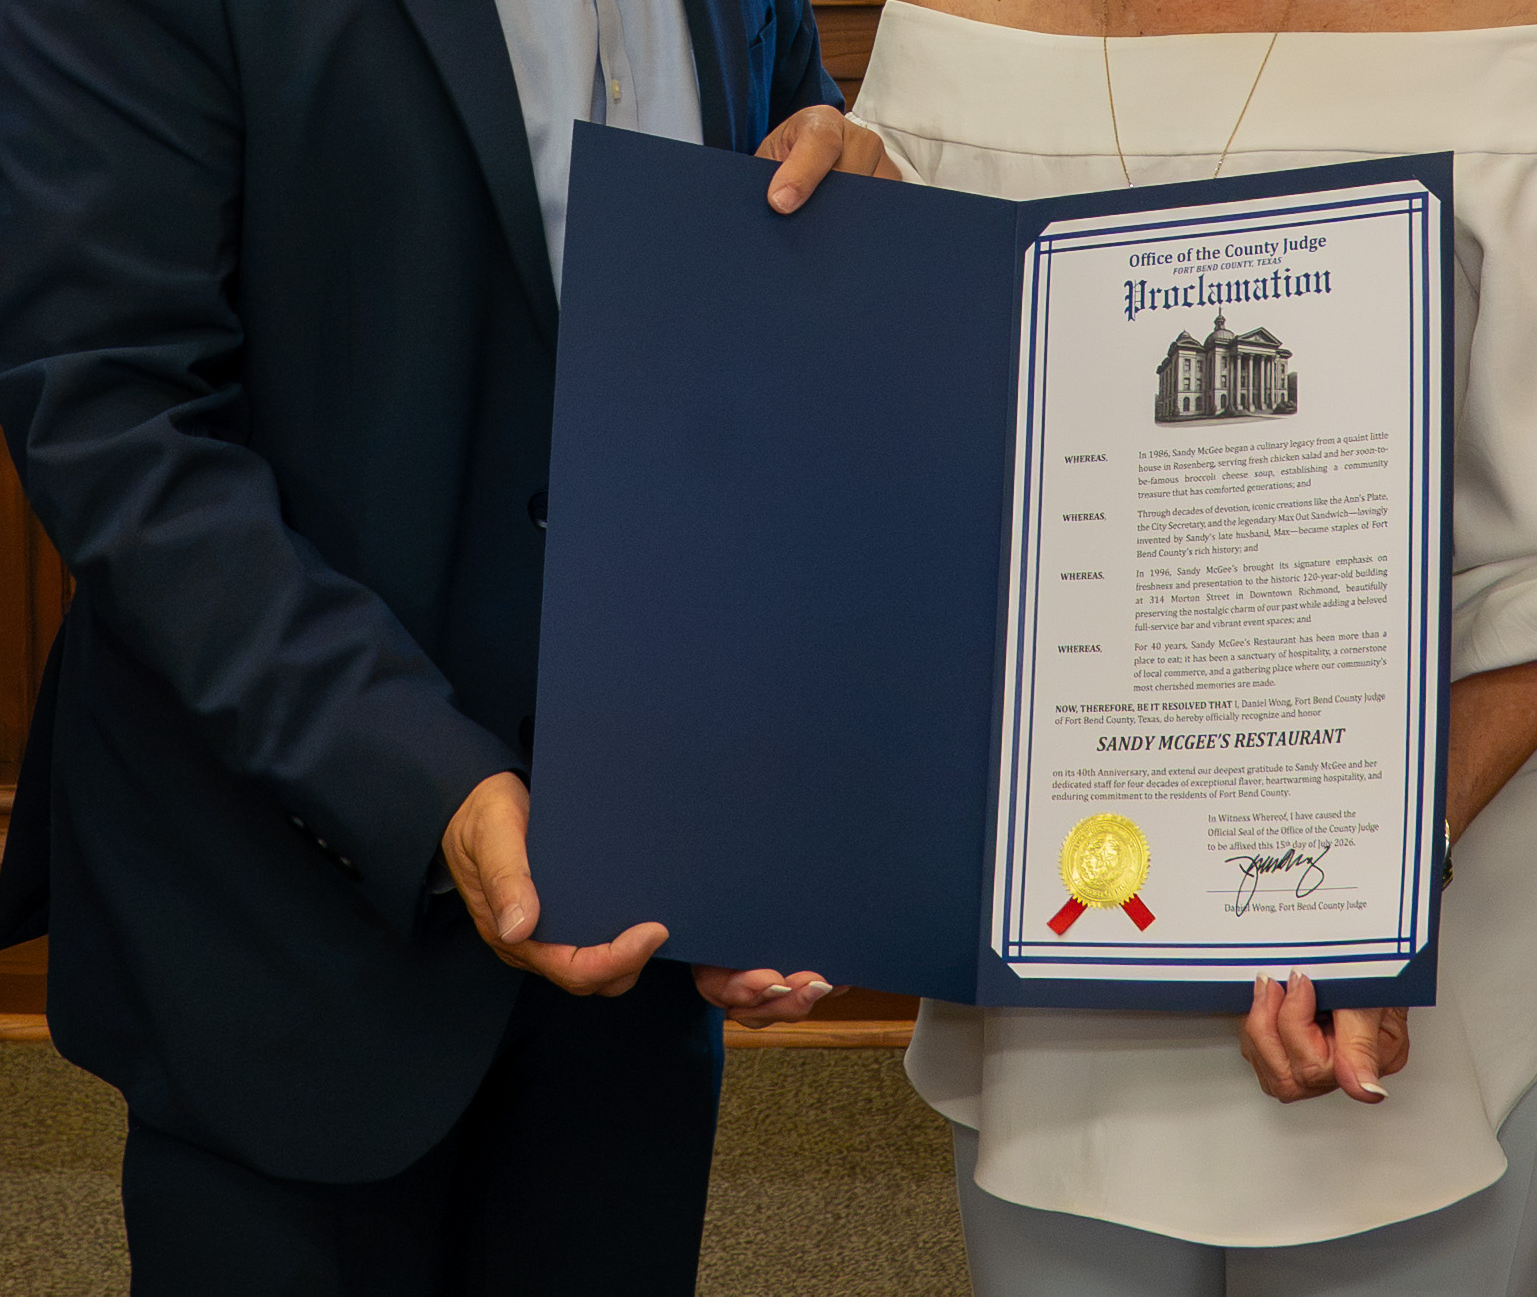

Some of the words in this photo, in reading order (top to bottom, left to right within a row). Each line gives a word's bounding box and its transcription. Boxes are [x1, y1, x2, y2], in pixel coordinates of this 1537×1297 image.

[1129, 253, 1173, 268] Office
[1177, 249, 1193, 264] of
[1195, 247, 1220, 262] the
[1224, 242, 1279, 259] County
[1282, 235, 1327, 254] Judge
[1173, 266, 1195, 276] FORT
[1196, 264, 1219, 274] BEND
[1256, 257, 1282, 267] TEXAS
[1124, 267, 1332, 322] Proclamation
[1171, 447, 1196, 459] Sandy
[1197, 445, 1223, 455] McGee
[1224, 443, 1248, 456] began
[1256, 440, 1289, 453] culinary
[1289, 438, 1315, 451] legacy
[1316, 436, 1335, 446] from
[1342, 433, 1368, 446] quaint
[1370, 431, 1389, 441] little
[1136, 548, 1157, 557] Bend
[1194, 545, 1210, 554] rich
[1243, 542, 1258, 552] and
[1148, 594, 1164, 603] 314
[1170, 592, 1200, 602] Morton
[1205, 591, 1229, 601] Street
[1249, 588, 1292, 598] Downtown
[1345, 581, 1387, 595] beautifully
[1136, 702, 1149, 710] BE
[1161, 700, 1206, 709] RESOLVED
[1207, 699, 1232, 708] THAT
[1241, 698, 1266, 706] Daniel
[1294, 696, 1311, 704] Fort
[1312, 695, 1333, 704] Bend
[1334, 693, 1362, 705] County
[1364, 692, 1385, 704] Judge
[1063, 716, 1081, 724] Fort
[1083, 715, 1104, 724] Bend
[1175, 712, 1204, 723] hereby
[1205, 711, 1239, 722] officially
[1241, 710, 1279, 721] recognize
[1280, 709, 1296, 718] and
[1297, 708, 1321, 717] honor
[1096, 735, 1155, 752] SANDY
[1157, 732, 1231, 750] MCGEE'S
[1233, 728, 1346, 747] RESTAURANT
[1076, 768, 1096, 776] 40th
[1150, 766, 1166, 775] and
[1167, 766, 1195, 774] extend
[1213, 764, 1245, 776] deepest
[1246, 763, 1283, 775] gratitude
[1294, 762, 1319, 773] Sandy
[1320, 761, 1346, 770] McGee
[1347, 760, 1362, 769] and
[1364, 759, 1377, 768] her
[1051, 780, 1091, 789] dedicated
[1093, 780, 1112, 788] staff
[1113, 779, 1126, 788] for
[1127, 779, 1144, 787] four
[1145, 778, 1179, 787] decades
[1189, 776, 1236, 788] exceptional
[1265, 773, 1321, 786] heartwarming
[1367, 771, 1382, 780] and
[1051, 791, 1089, 802] enduring
[1089, 790, 1142, 799] commitment
[1154, 790, 1168, 798] the
[1169, 789, 1207, 798] residents
[1218, 789, 1236, 797] Fort
[1238, 789, 1259, 797] Bend
[1217, 813, 1250, 821] Witness
[1294, 811, 1313, 820] have
[1314, 810, 1342, 819] caused
[1343, 809, 1356, 818] the
[1207, 827, 1236, 836] Official
[1237, 827, 1254, 835] Seal
[1265, 826, 1279, 835] the
[1280, 826, 1303, 834] Office
[1314, 825, 1327, 833] the
[1328, 823, 1356, 835] County
[1357, 822, 1379, 834] Judge
[1228, 841, 1256, 849] affixed
[1257, 840, 1273, 849] this
[1291, 839, 1306, 850] day
[1278, 902, 1294, 910] Fort
[1296, 901, 1316, 910] Bend
[1317, 900, 1345, 912] County
[1346, 900, 1367, 911] Judge
